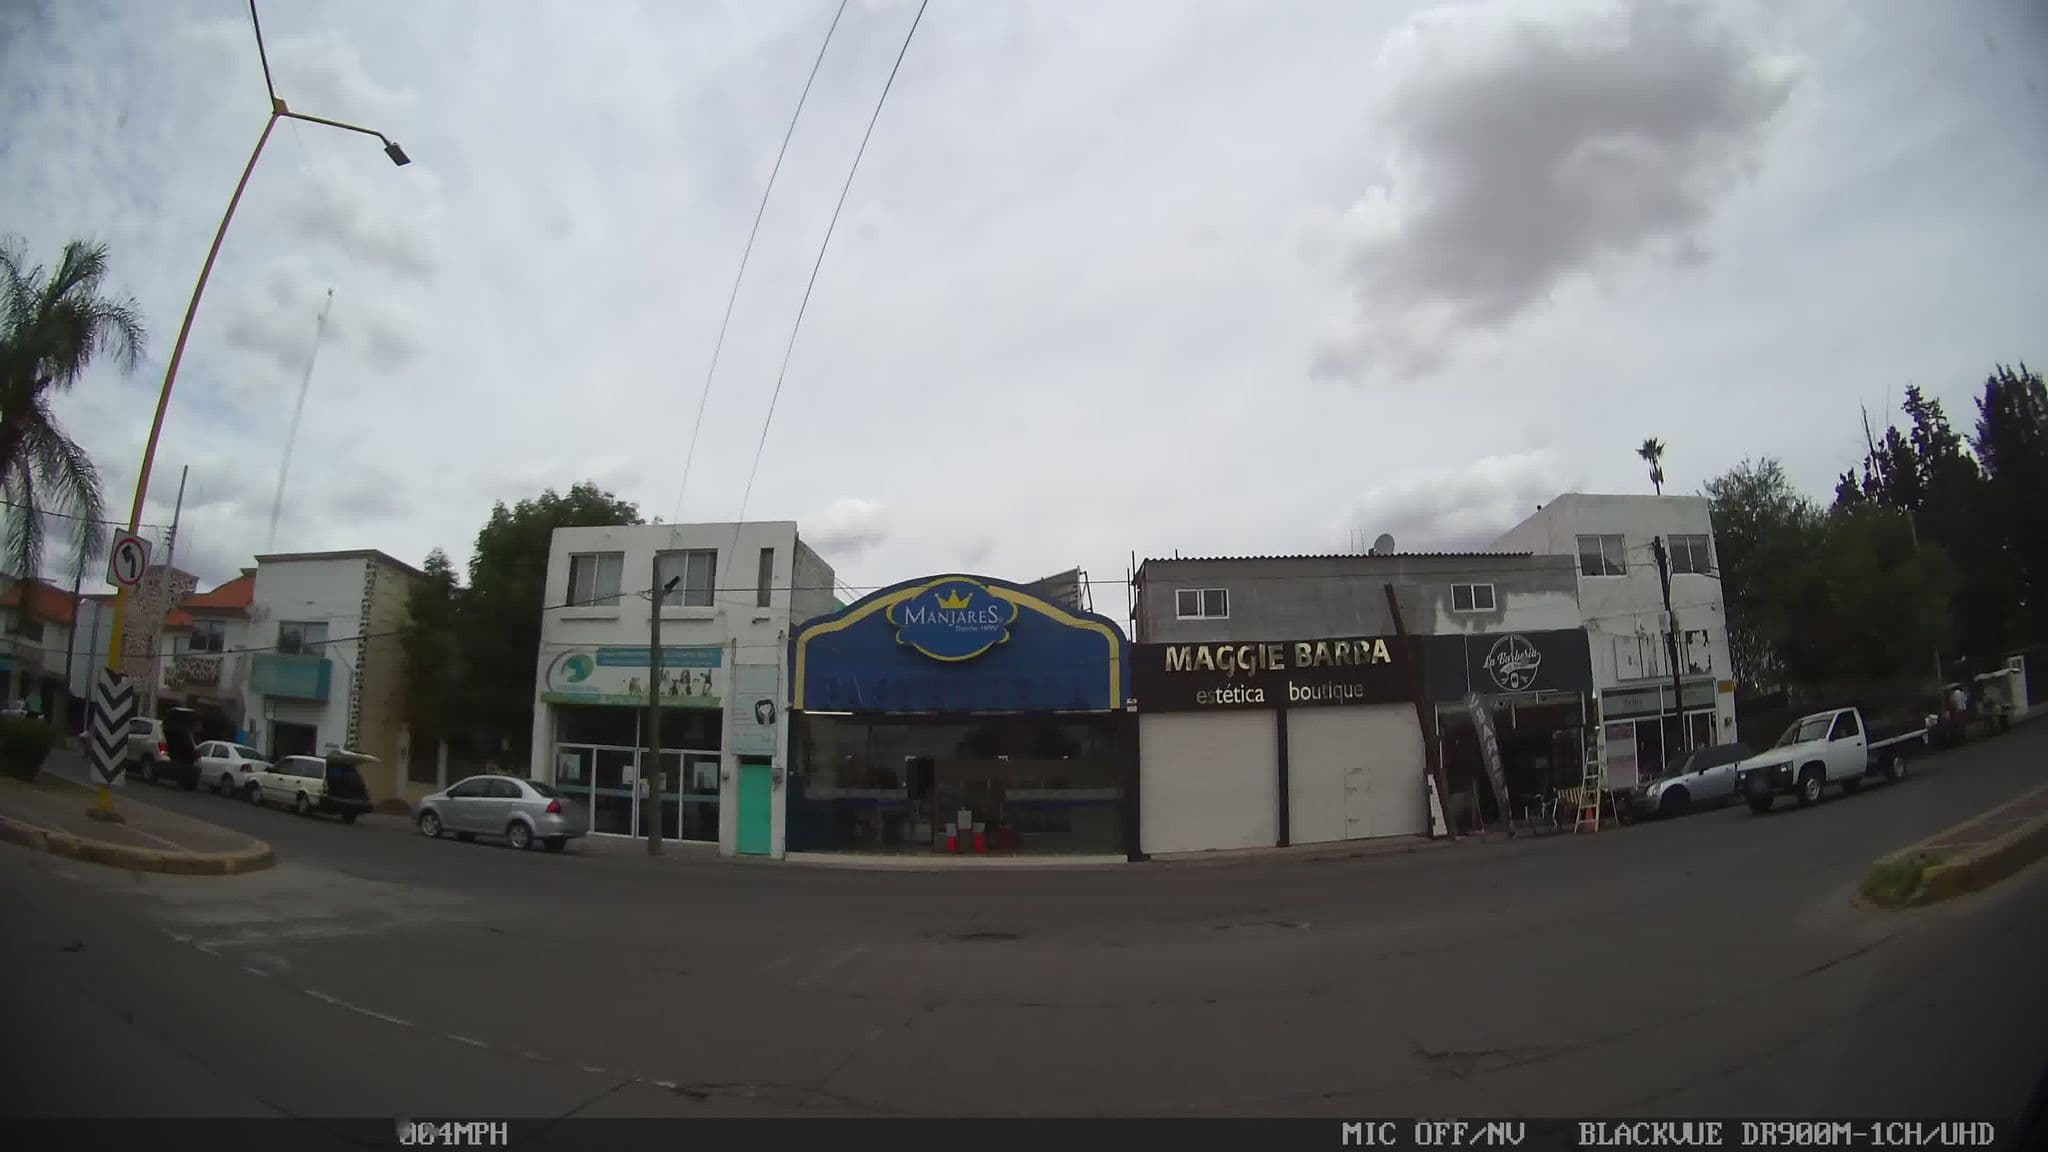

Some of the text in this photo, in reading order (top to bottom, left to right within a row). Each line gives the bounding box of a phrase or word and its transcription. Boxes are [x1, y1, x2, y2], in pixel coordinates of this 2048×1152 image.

[1164, 638, 1392, 677] MAGGIE BARBA
[1196, 680, 1364, 705] estética boutique
